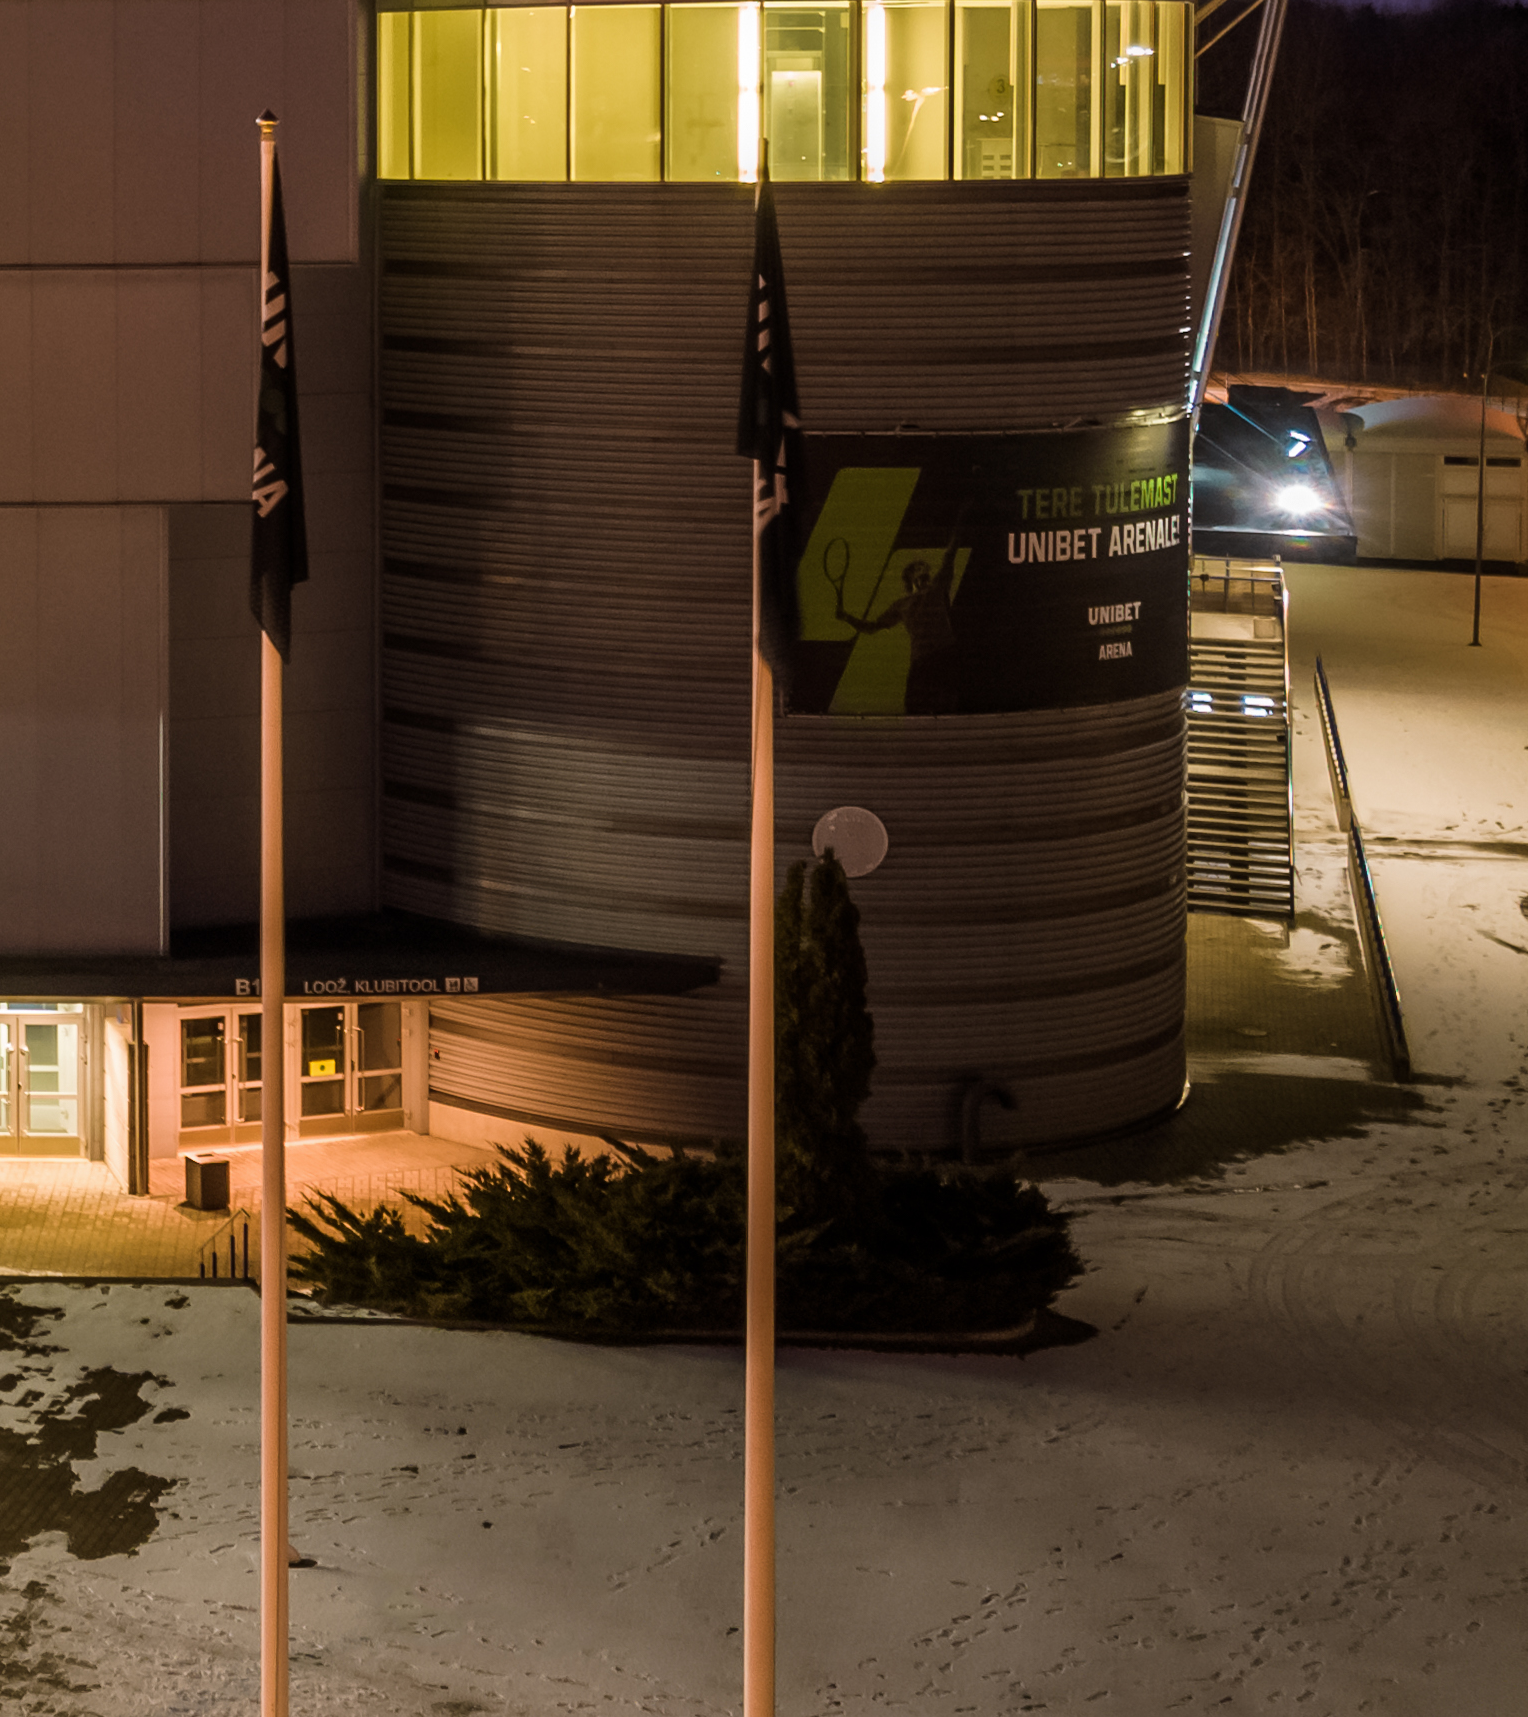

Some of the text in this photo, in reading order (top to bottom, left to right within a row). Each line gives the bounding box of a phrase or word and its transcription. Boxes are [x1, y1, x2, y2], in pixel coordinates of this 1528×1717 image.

[1016, 473, 1178, 520] TERE TULEMAST
[1008, 514, 1180, 564] UNIBET ARENALE!
[1088, 601, 1141, 625] UNIBET
[1098, 641, 1133, 661] ARENA
[355, 978, 441, 993] KLUBITOOL
